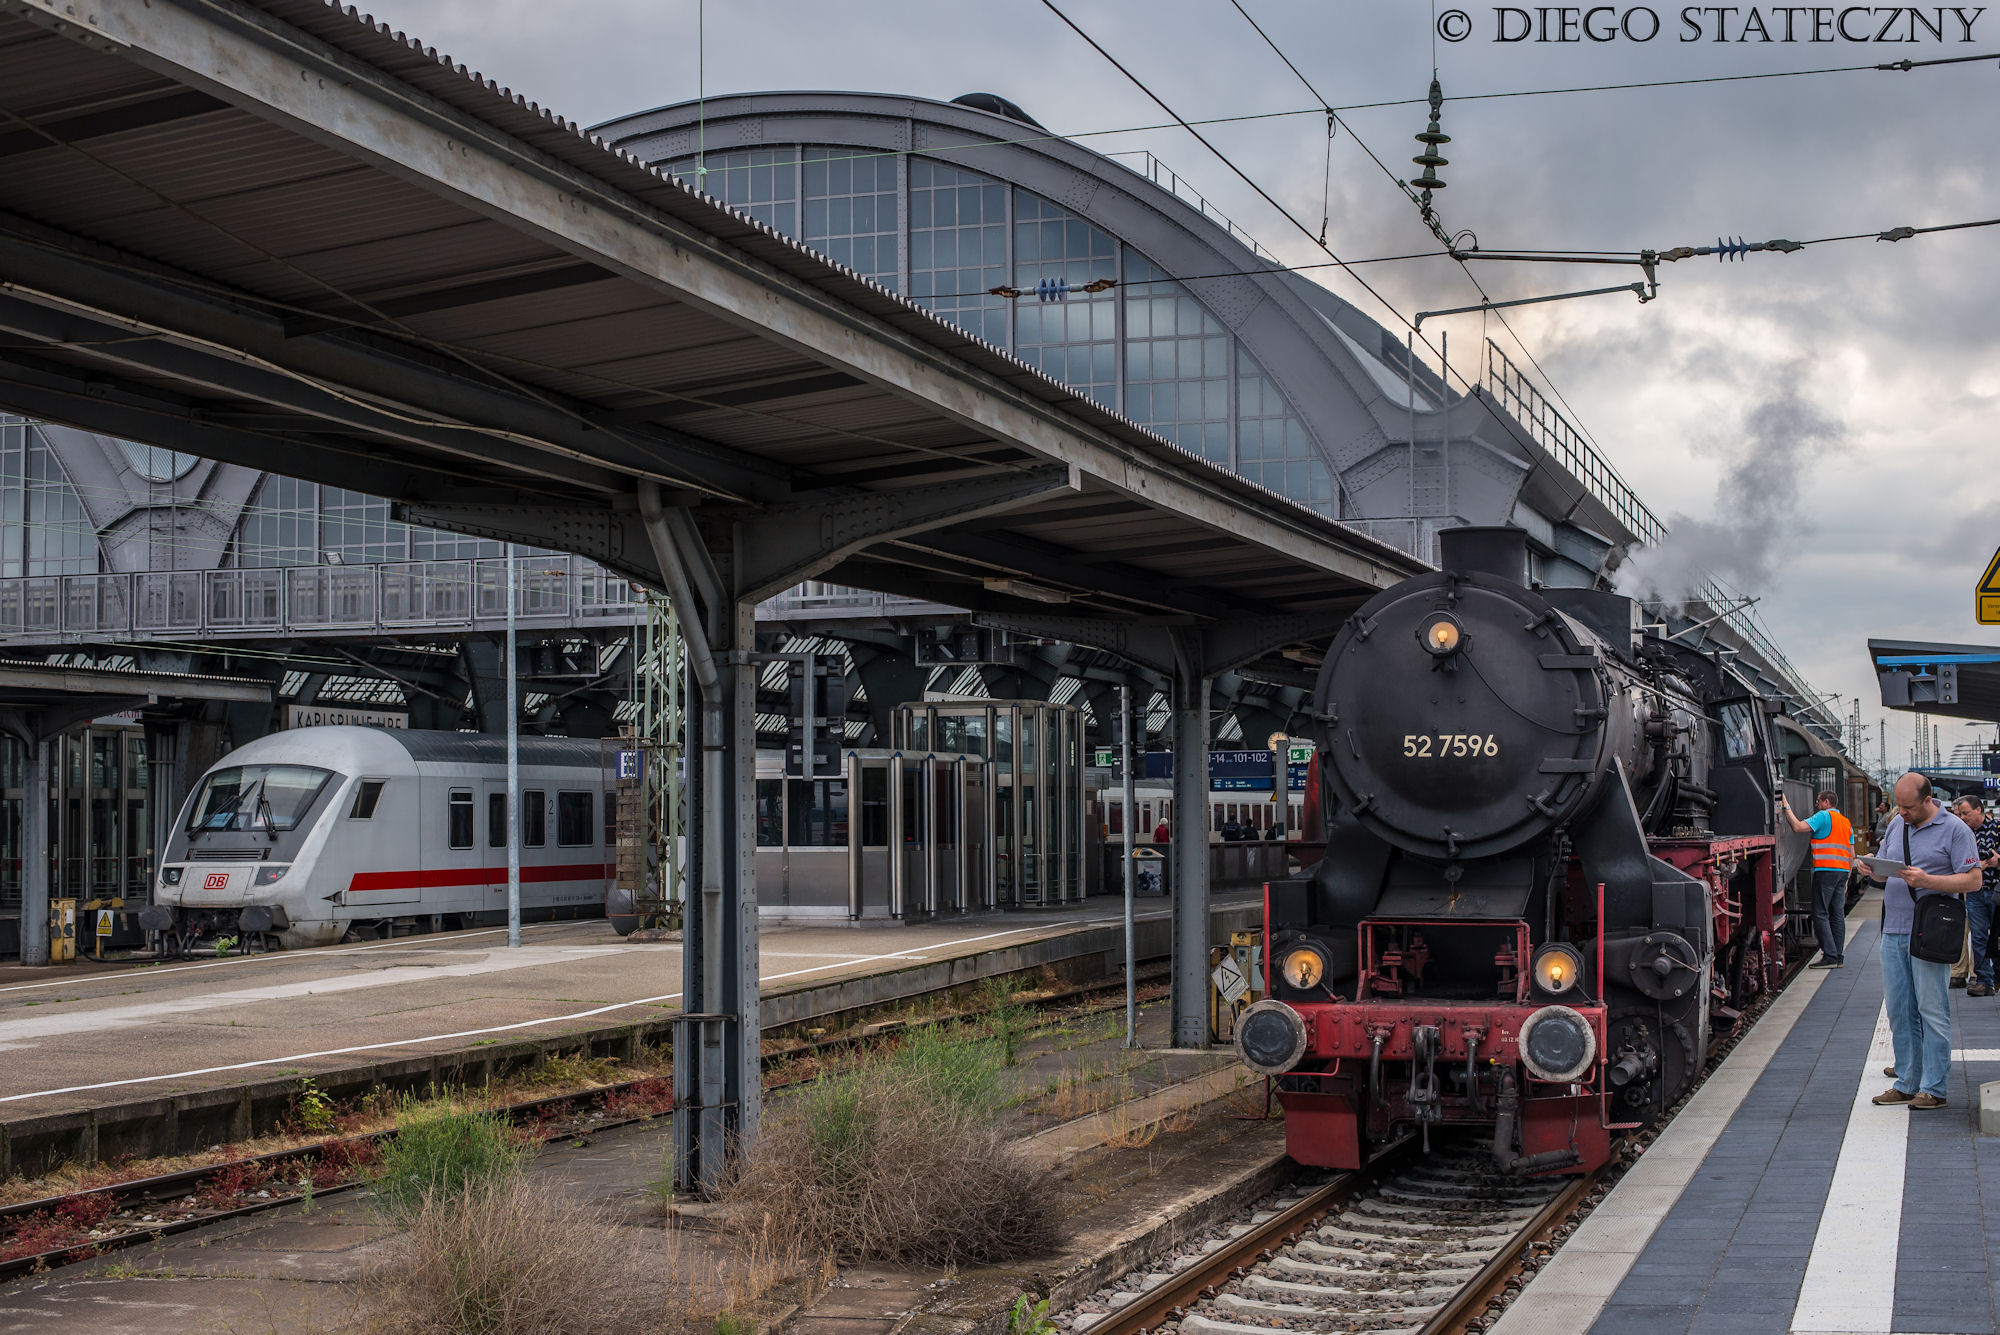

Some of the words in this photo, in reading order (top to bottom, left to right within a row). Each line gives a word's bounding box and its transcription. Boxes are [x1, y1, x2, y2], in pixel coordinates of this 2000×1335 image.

[1403, 735, 1432, 757] 52
[1438, 734, 1499, 757] 7596
[1233, 753, 1268, 763] 101-102
[548, 799, 554, 815] 2
[206, 875, 226, 888] DB
